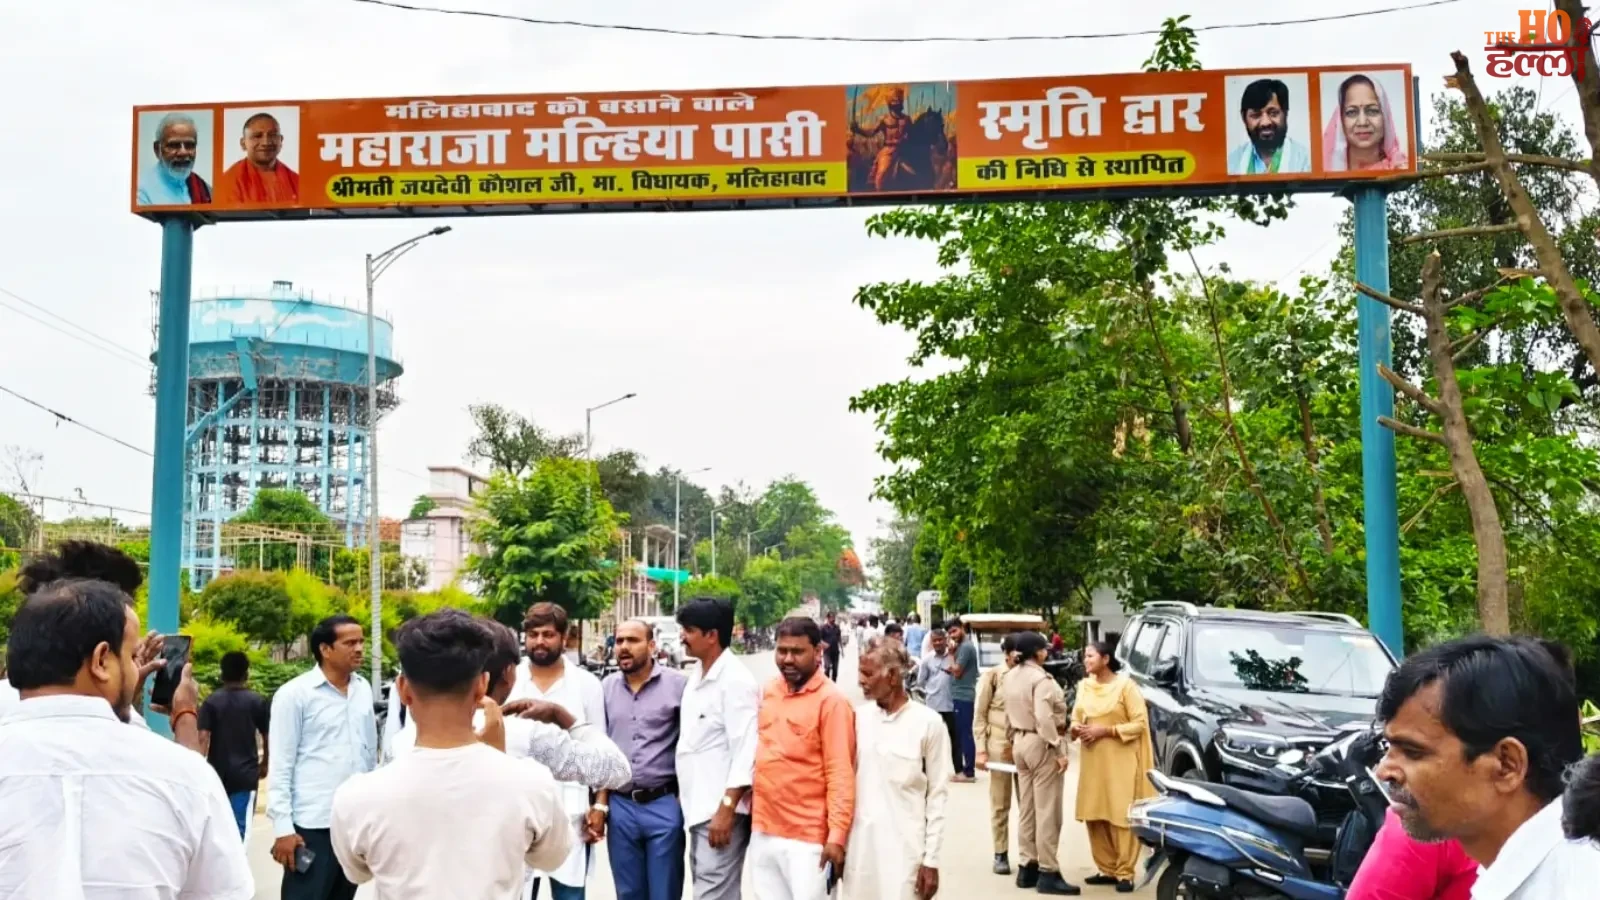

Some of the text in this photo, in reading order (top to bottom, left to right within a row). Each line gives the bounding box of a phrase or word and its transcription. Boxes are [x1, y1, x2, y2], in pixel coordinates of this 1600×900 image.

[384, 92, 757, 120] मलिहाबाद को बसाने वाले
[977, 86, 1207, 150] स्मृति द्वार
[317, 109, 827, 168] महाराजा मल्हिया पासी
[331, 167, 827, 198] श्रीमती जयदेवी कौशल जी, मा. विधायक, मलिहाबाद
[976, 154, 1186, 181] की निधि से स्थापित
